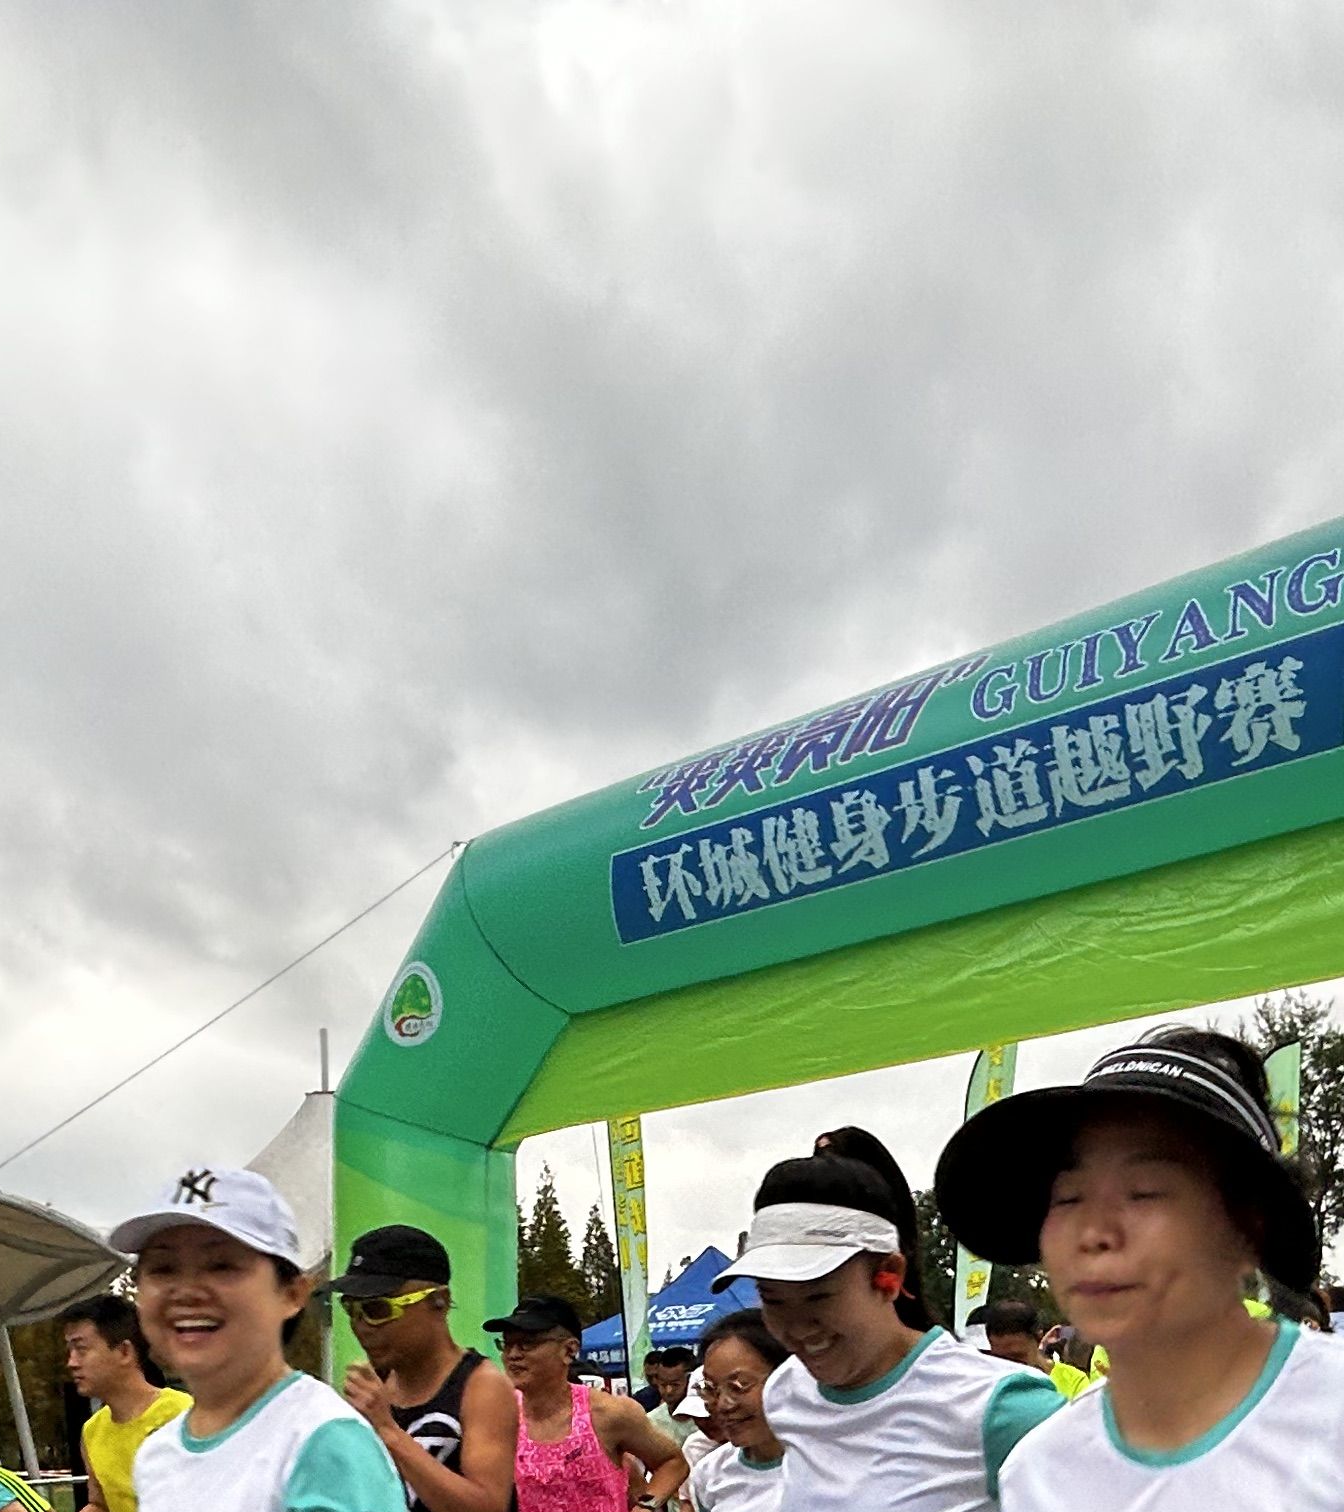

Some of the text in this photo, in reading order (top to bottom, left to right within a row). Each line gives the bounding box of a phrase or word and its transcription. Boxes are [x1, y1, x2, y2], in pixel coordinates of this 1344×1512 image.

[638, 654, 1308, 924] 环城健身步道越野赛
